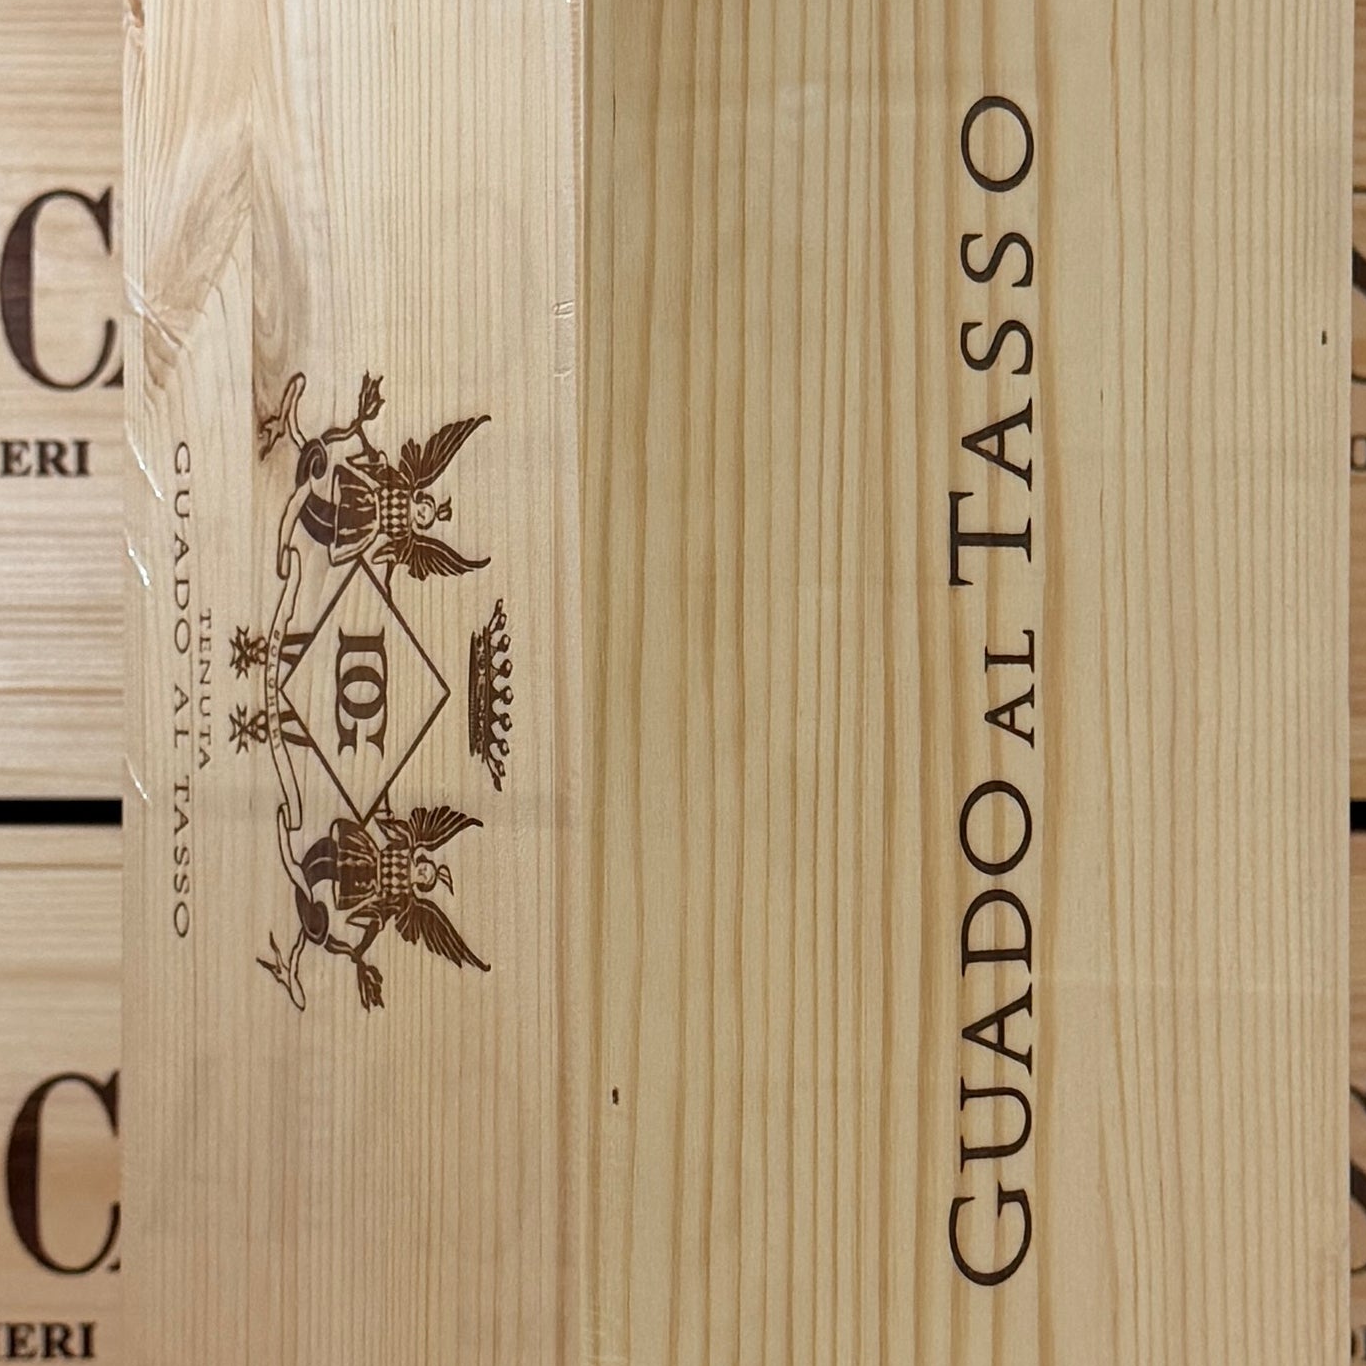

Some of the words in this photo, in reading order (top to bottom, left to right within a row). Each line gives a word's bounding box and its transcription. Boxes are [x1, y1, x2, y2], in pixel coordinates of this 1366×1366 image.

[948, 94, 1035, 588] TASSO
[173, 440, 191, 656] GUADO
[173, 682, 191, 749] AL
[197, 607, 212, 770] TENUTA
[982, 628, 1035, 749] AL
[173, 774, 191, 940] TASSO
[948, 778, 1034, 1287] GUADO
